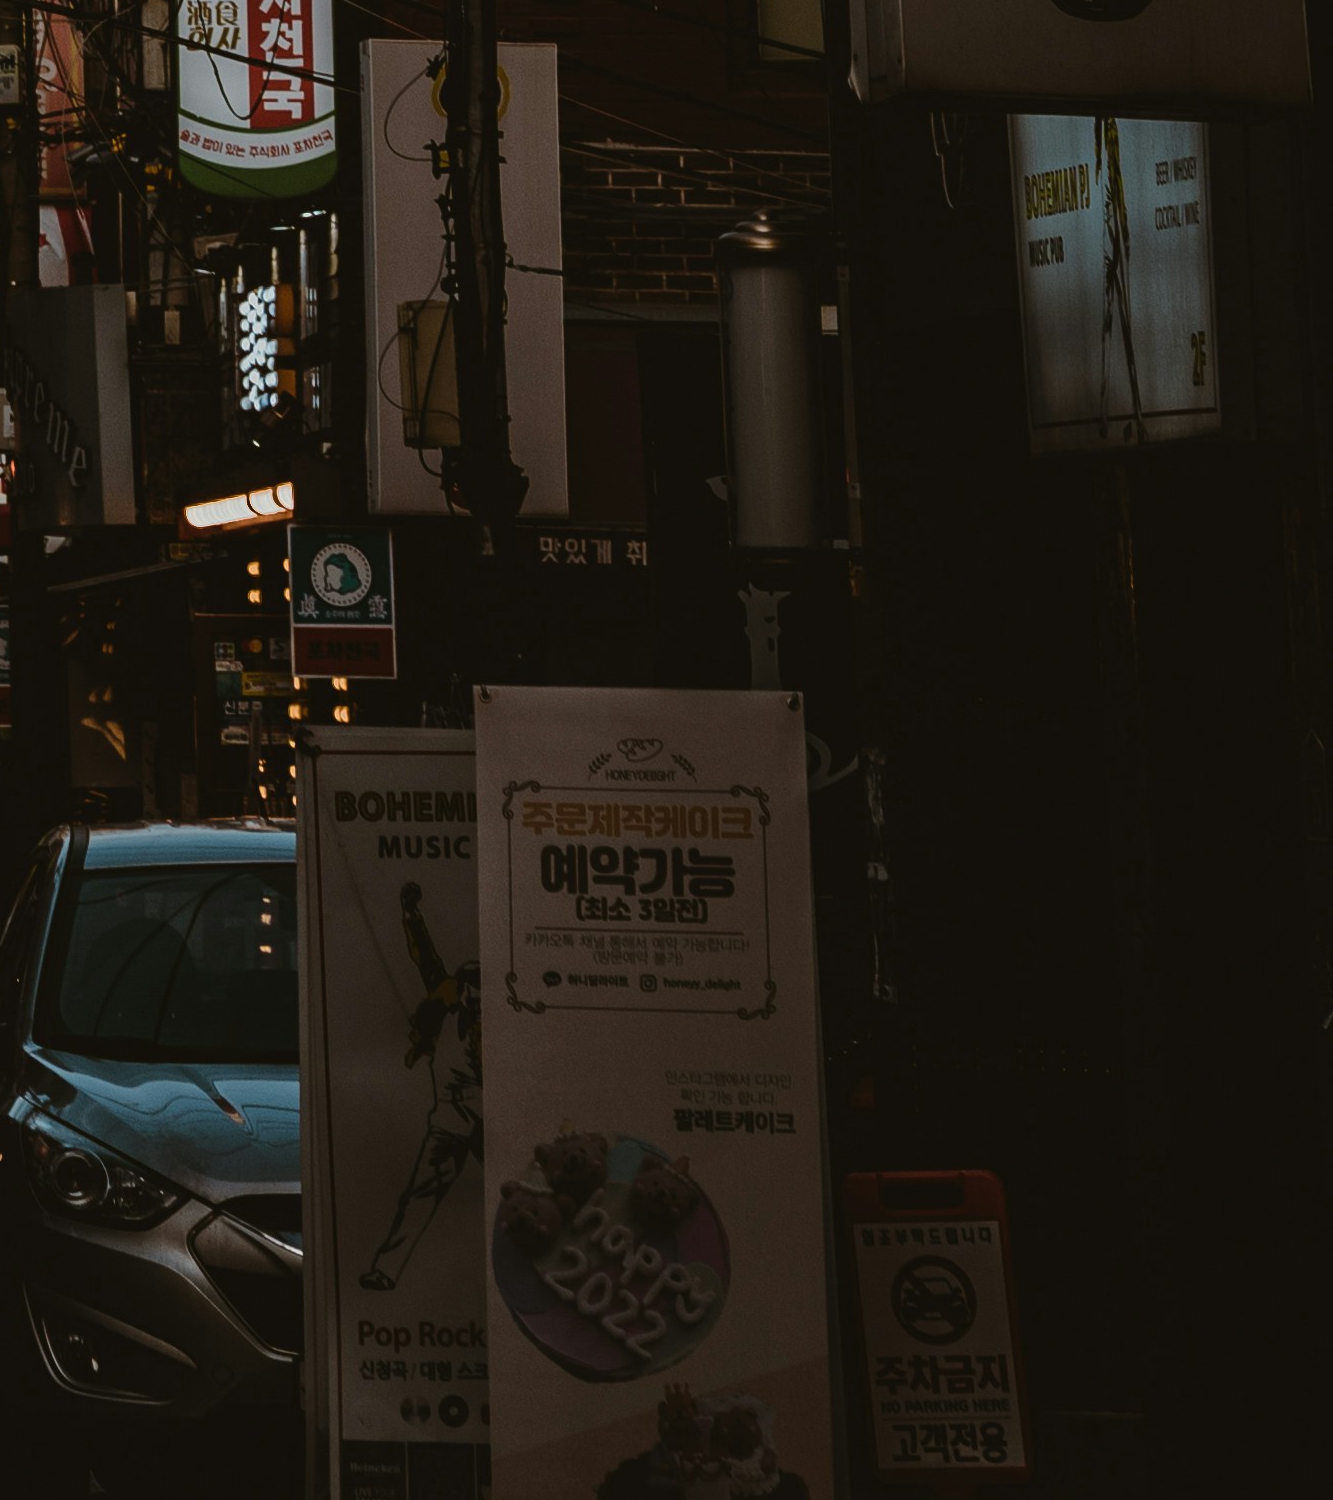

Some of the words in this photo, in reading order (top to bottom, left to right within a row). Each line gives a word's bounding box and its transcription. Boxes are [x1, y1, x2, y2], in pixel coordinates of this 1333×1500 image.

[224, 142, 246, 158] 있는
[248, 143, 292, 159] 주식회사
[293, 129, 334, 154] 포차천국
[1024, 164, 1078, 221] BOHEMIAN
[1028, 238, 1050, 268] MUSIC
[1050, 236, 1065, 264] PUB
[538, 535, 614, 567] 맛있게
[521, 801, 754, 840] 주문제작케이크
[377, 836, 472, 860] MUSIC
[540, 844, 736, 899] 예약가능
[652, 936, 678, 951] 예약
[673, 1107, 798, 1136] 팔레트케이크
[860, 1226, 993, 1248] 협조부탁드립니다
[573, 1187, 718, 1325] happy
[542, 1244, 653, 1360] 2022
[357, 1319, 413, 1354] Pop
[418, 1319, 487, 1348] Rock
[874, 1353, 1011, 1395] 주차금지
[880, 1399, 902, 1415] NO
[904, 1398, 970, 1414] PARKING
[973, 1397, 1011, 1413] HERE
[891, 1421, 1009, 1464] 고객전용
[348, 1461, 402, 1475] Heineken
